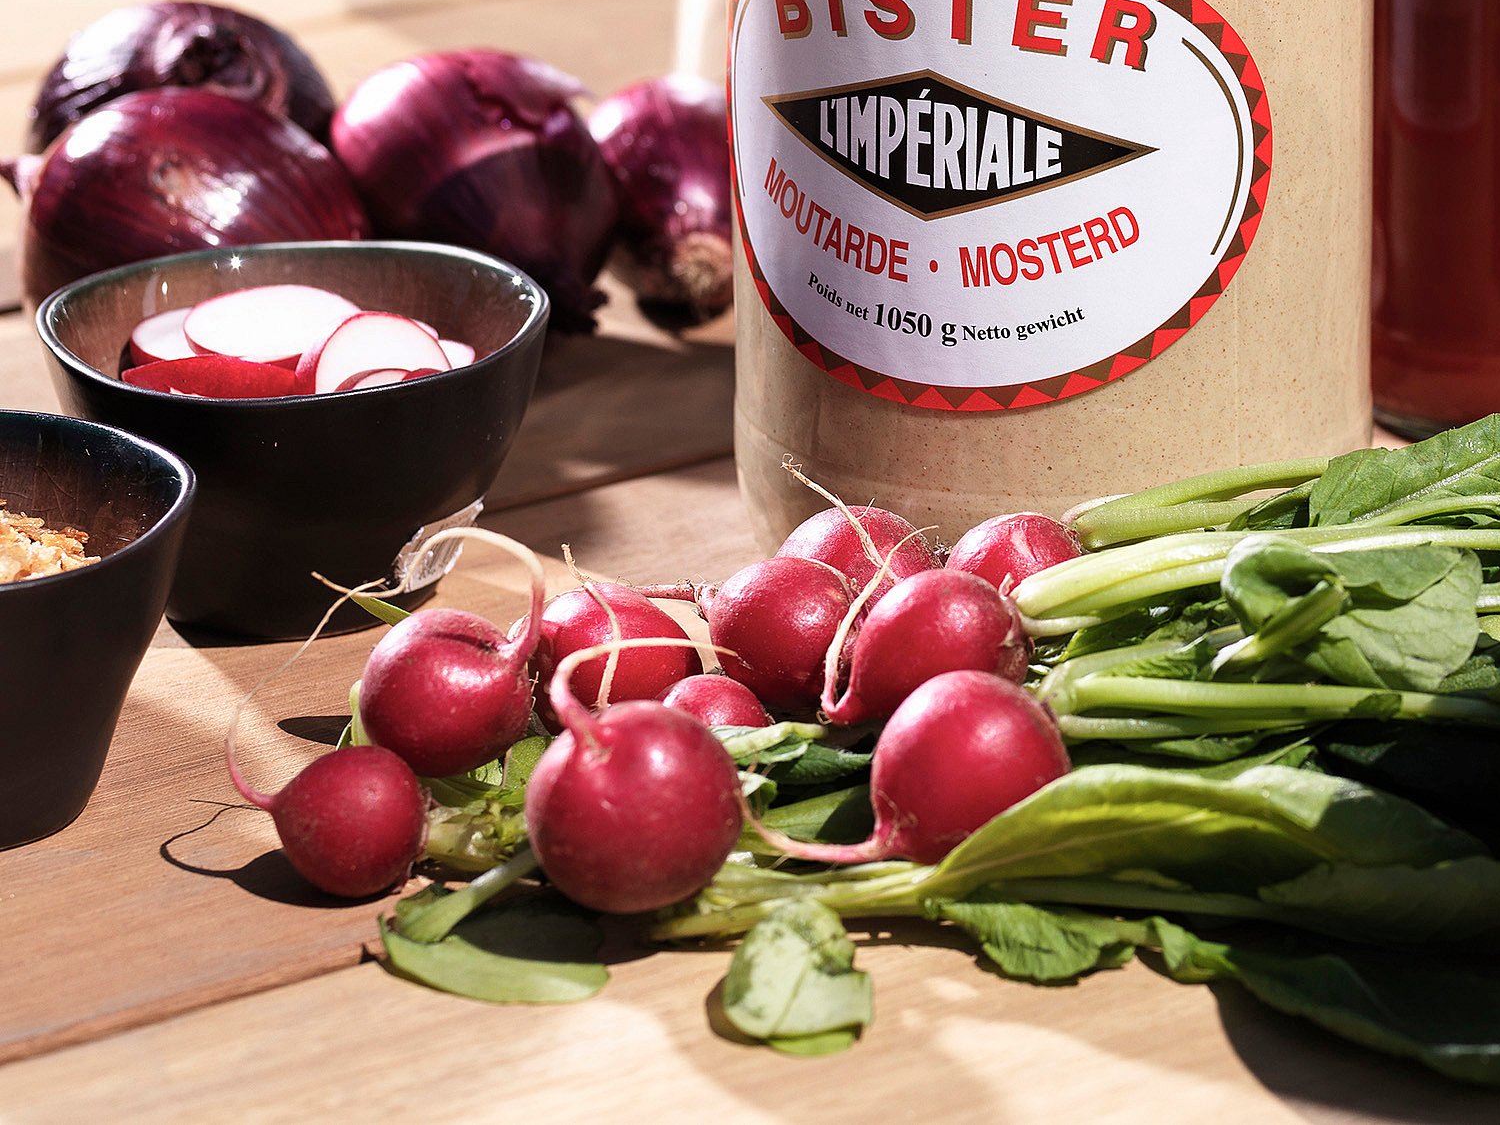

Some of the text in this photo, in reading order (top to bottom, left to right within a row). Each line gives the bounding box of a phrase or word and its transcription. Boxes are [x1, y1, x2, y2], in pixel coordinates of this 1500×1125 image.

[820, 89, 1062, 191] L'IMPÉRIALE
[763, 157, 1140, 288] MOUTARDE MOSTERD
[807, 271, 1086, 347] Poids net 1050 g Netto gewicht
